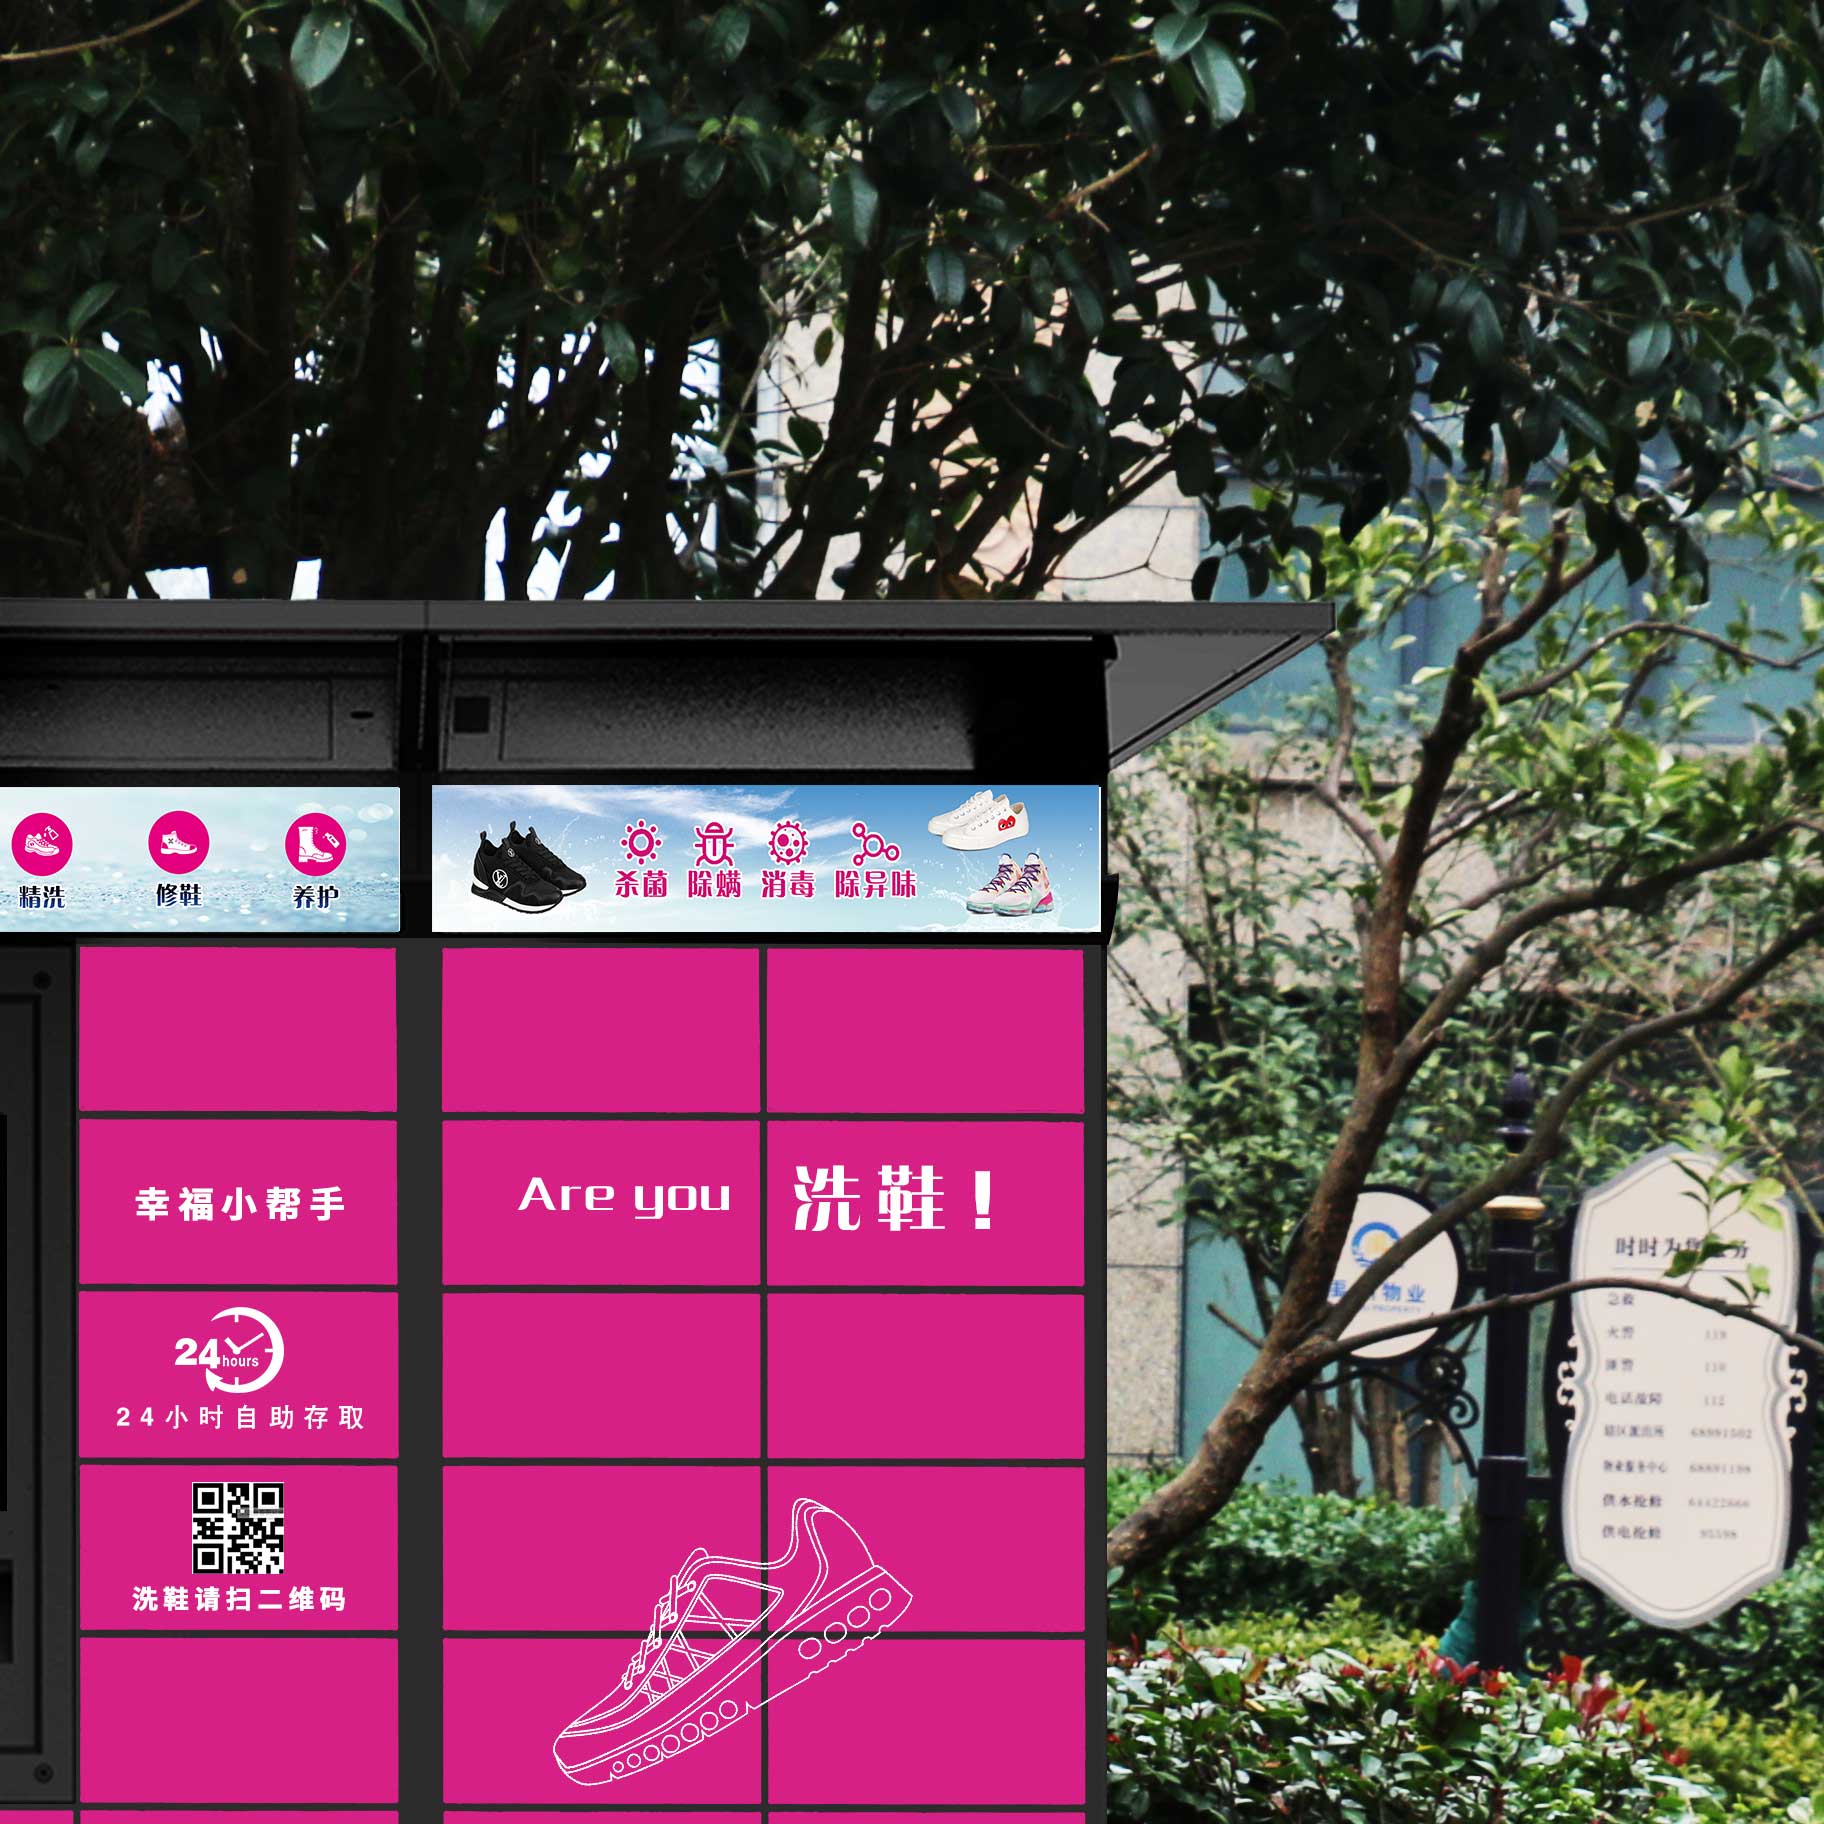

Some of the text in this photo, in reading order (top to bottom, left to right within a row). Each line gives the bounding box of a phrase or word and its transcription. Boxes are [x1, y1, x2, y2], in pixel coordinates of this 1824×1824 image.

[19, 885, 65, 909] 精洗
[156, 883, 202, 907] 修鞋
[293, 885, 339, 909] 养护
[615, 869, 916, 899] 杀菌 除螨 消毒 除异味
[135, 1185, 345, 1222] 幸福小帮手
[517, 1176, 615, 1211] Are
[634, 1185, 730, 1220] you
[175, 1337, 259, 1369] 24 hours
[116, 1404, 364, 1430] 24小时自助存取
[132, 1585, 346, 1612] 洗鞋请扫二维码
